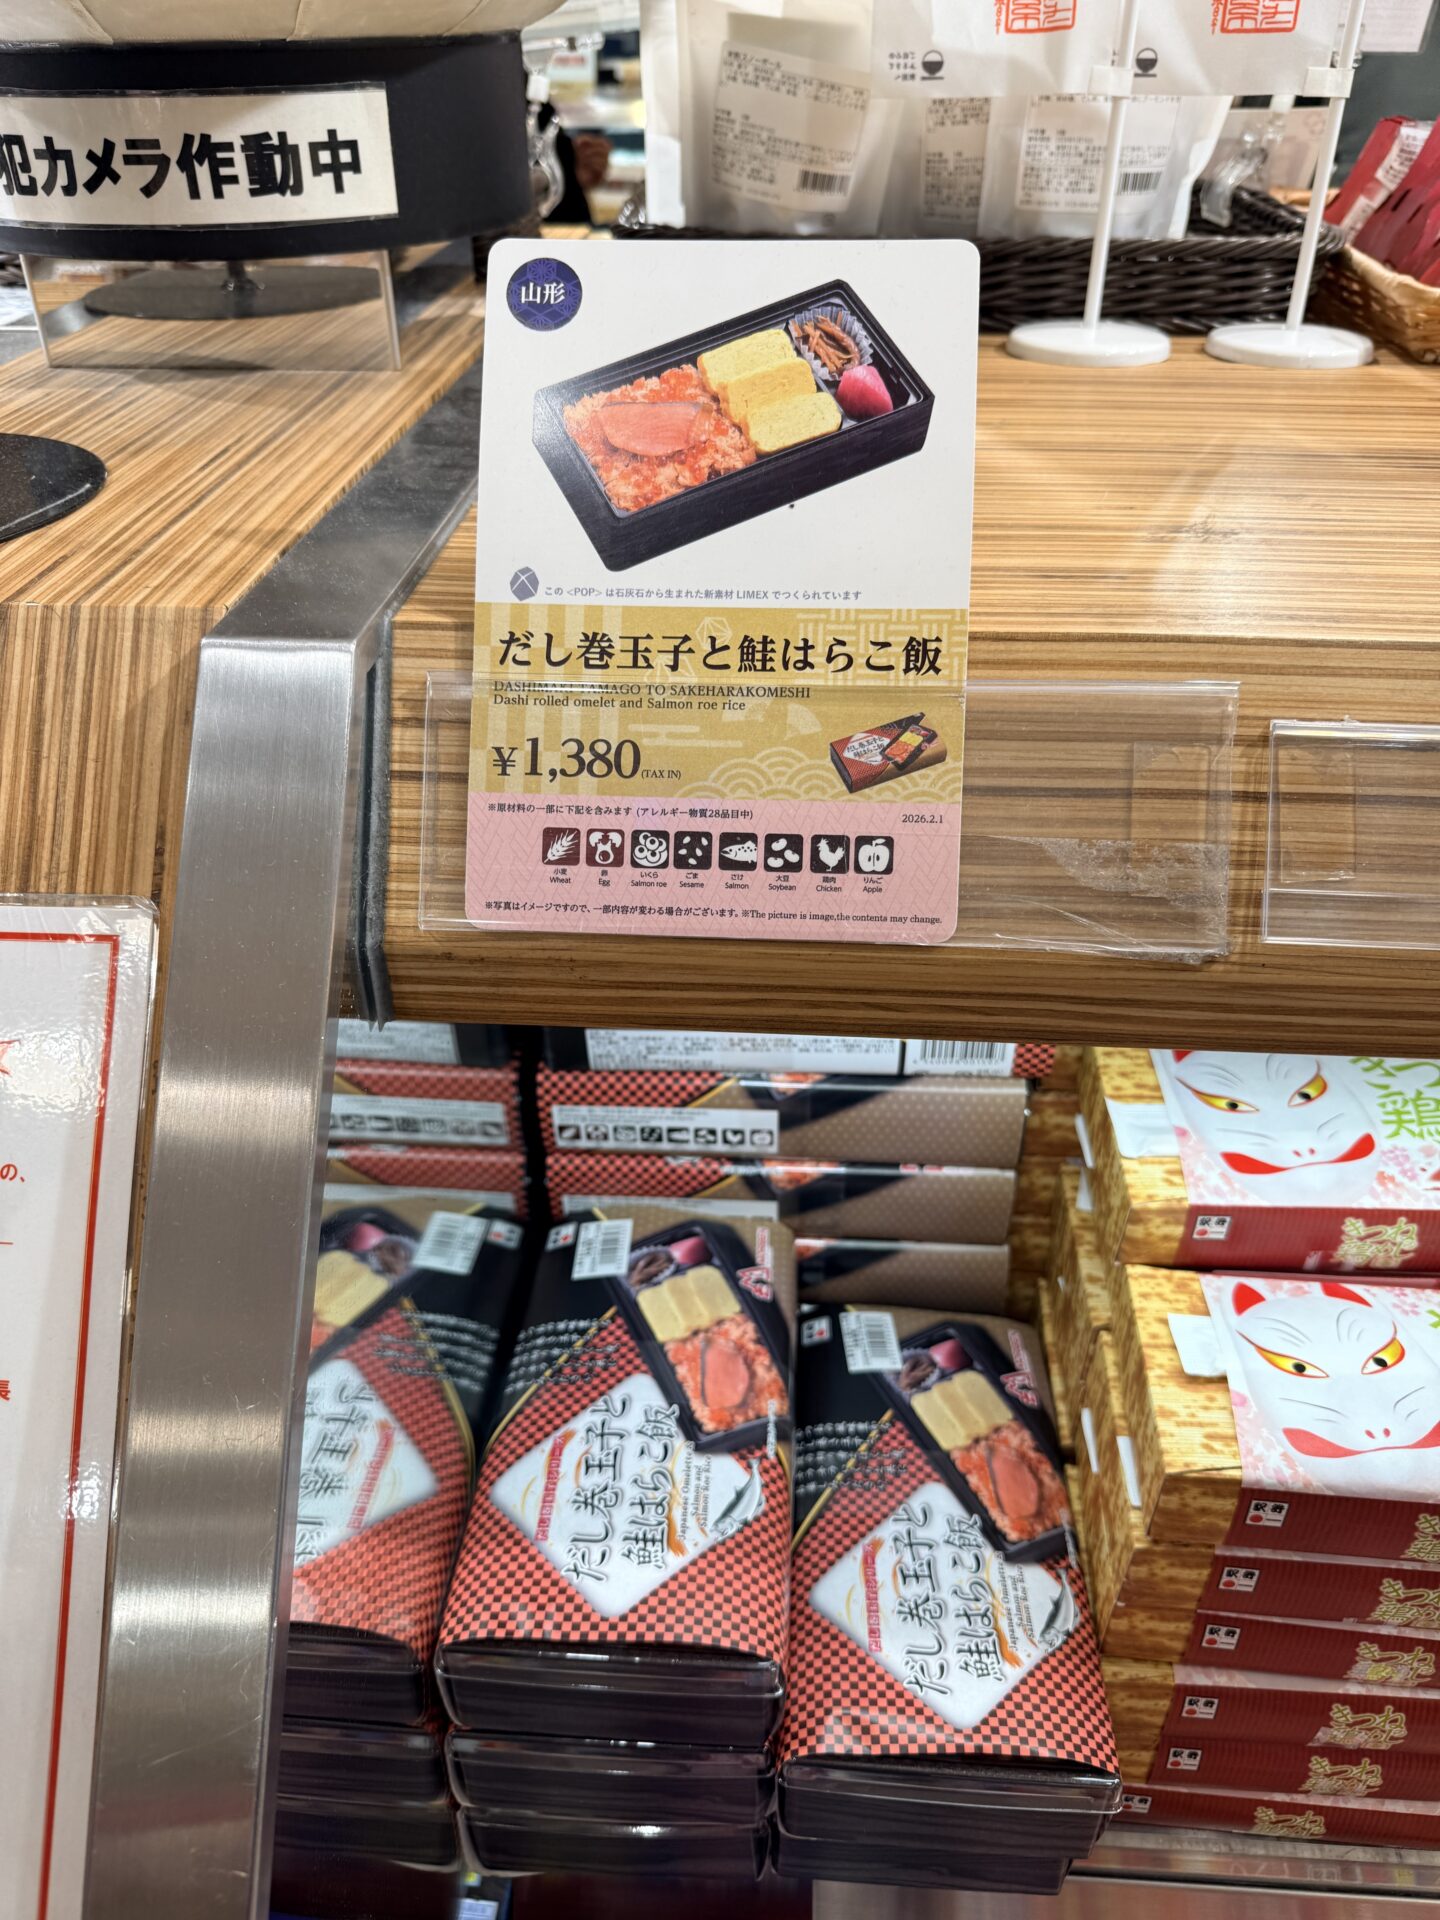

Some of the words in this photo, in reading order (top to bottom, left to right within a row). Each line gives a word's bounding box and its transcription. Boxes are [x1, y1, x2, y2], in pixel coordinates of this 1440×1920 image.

[0, 128, 362, 200] 犯カメラ作動中
[519, 281, 566, 305] 山形
[544, 586, 564, 597] この
[566, 586, 603, 598] <POP>
[605, 587, 734, 600] は石灰石から生まれた新素材
[736, 590, 769, 600] LIMEX
[771, 590, 863, 600] でつくられています
[499, 630, 943, 676] だし巻玉子と鮭はらこ飯
[577, 682, 641, 695] TAMAGO
[645, 684, 666, 695] TO
[669, 684, 811, 699] SAKEHARAKOMESHI
[493, 694, 529, 706] Dashi
[532, 695, 570, 707] rolled
[573, 696, 615, 708] omelet
[619, 697, 643, 709] and
[647, 698, 693, 710] Salmon
[697, 701, 720, 711] roe
[723, 699, 746, 711] rice
[491, 737, 641, 783] ¥1,380
[641, 769, 665, 780] (TAX
[665, 769, 682, 780] IN)
[488, 802, 633, 816] ※原材料の一部に下記を含みます
[636, 806, 753, 820] (アレルギー物質28品目中)
[901, 813, 944, 824] 2026.2.1
[553, 868, 567, 876] 小麦
[640, 871, 659, 879] いくら
[549, 876, 571, 884] Wheat
[598, 878, 611, 887] Egg
[630, 880, 655, 888] Salmon
[724, 882, 750, 890] Salmon
[768, 883, 797, 892] Soybean
[816, 884, 842, 893] Chicken
[863, 885, 883, 894] Apple
[768, 911, 798, 921] picture
[800, 911, 807, 920] is
[852, 914, 888, 923] contents
[890, 916, 908, 925] may
[909, 914, 943, 925] change.
[562, 1395, 631, 1583] だし巻玉子と
[621, 1404, 680, 1570] 鮭はらこ飯
[690, 1484, 702, 1517] Salmon
[889, 1504, 951, 1696] だし巻玉子と
[943, 1513, 1004, 1682] 鮭はらこ飯
[1012, 1593, 1024, 1627] Salmon
